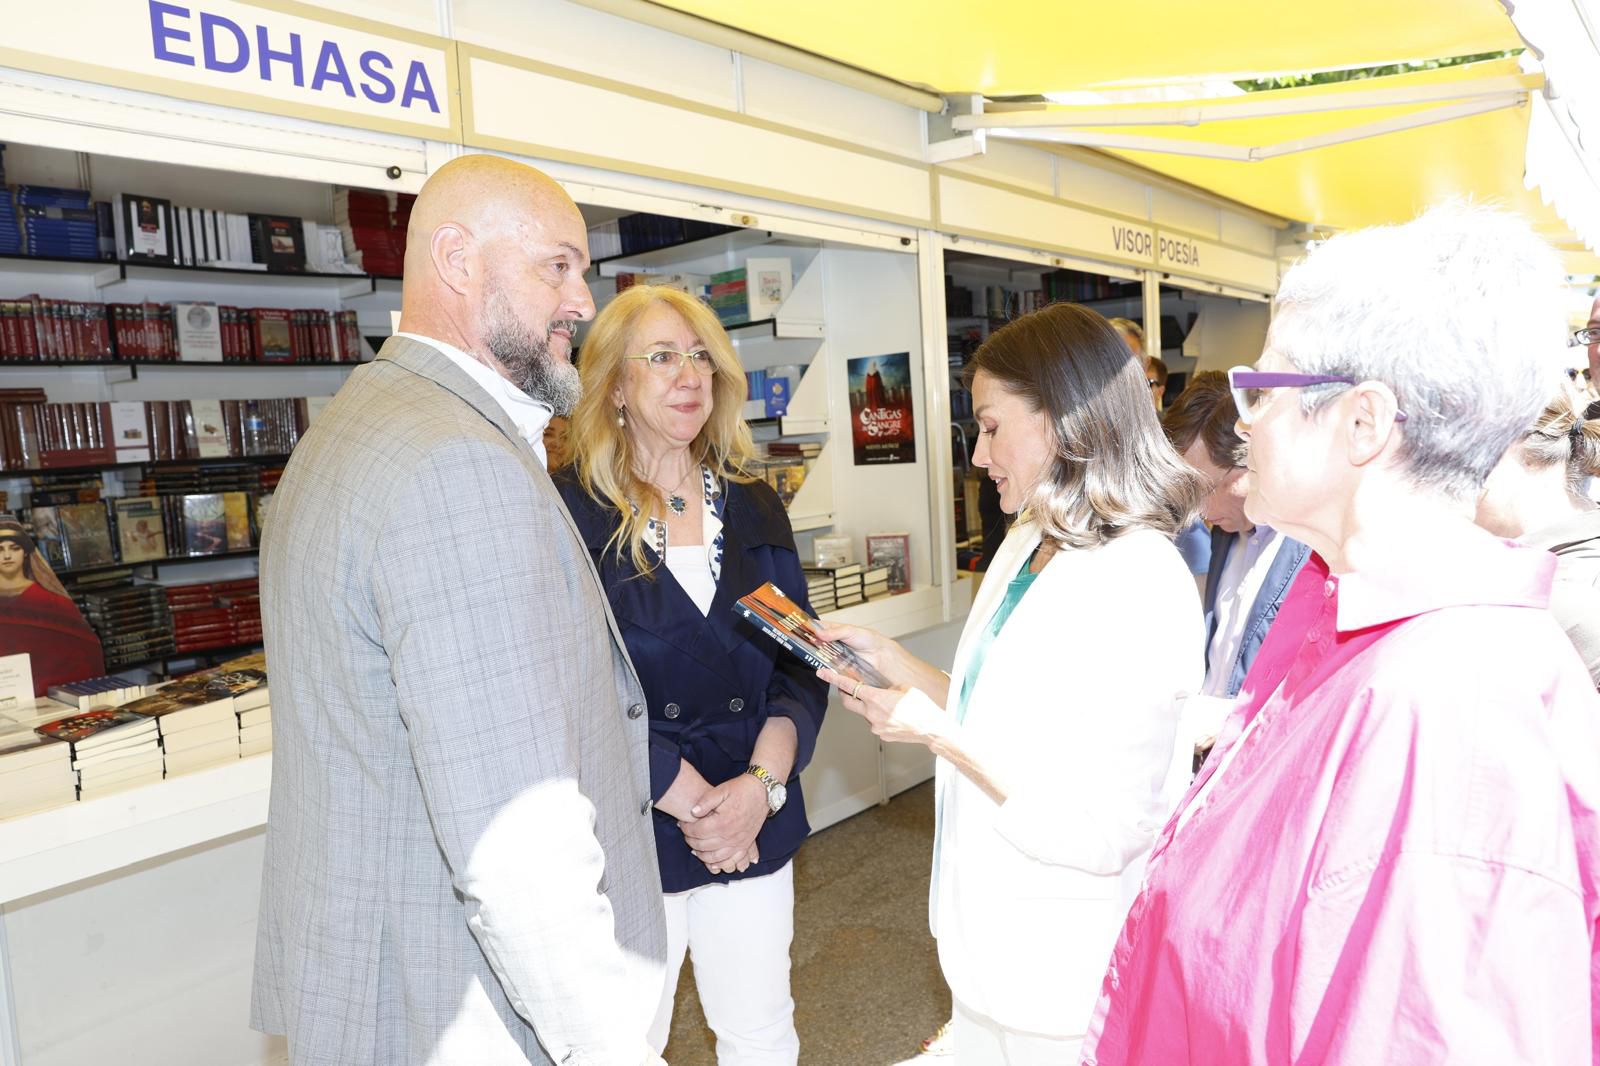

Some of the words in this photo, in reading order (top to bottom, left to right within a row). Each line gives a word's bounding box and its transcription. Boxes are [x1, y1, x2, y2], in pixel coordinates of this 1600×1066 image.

[148, 0, 441, 114] EDHASA
[1112, 226, 1152, 257] VISOR
[1158, 236, 1199, 266] POESÍA
[860, 407, 902, 425] CANTIGAS
[867, 420, 902, 437] SANGRE
